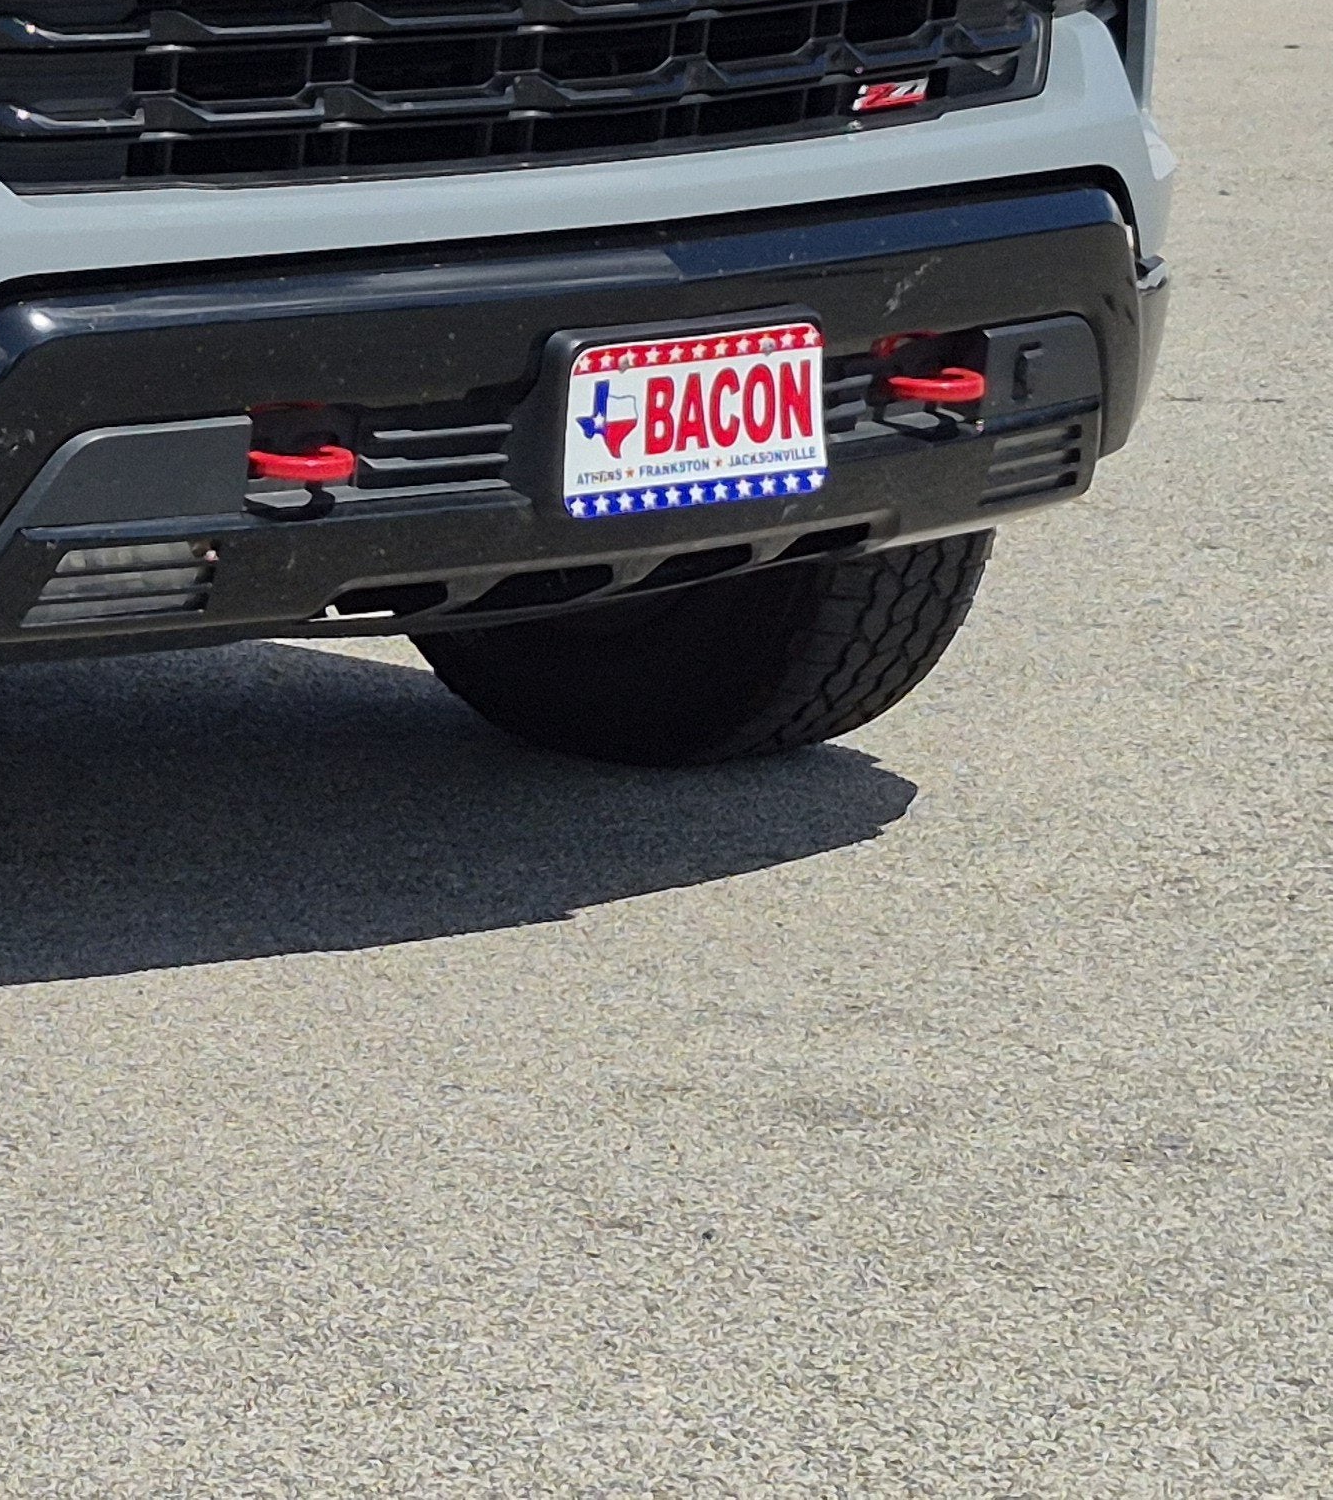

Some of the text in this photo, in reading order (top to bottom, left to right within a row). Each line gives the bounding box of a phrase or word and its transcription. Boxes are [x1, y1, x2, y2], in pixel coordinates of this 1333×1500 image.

[852, 77, 930, 113] Z71
[644, 359, 813, 455] BACON
[639, 457, 711, 479] FRANKSTON
[728, 446, 817, 468] JACKSONVILLE
